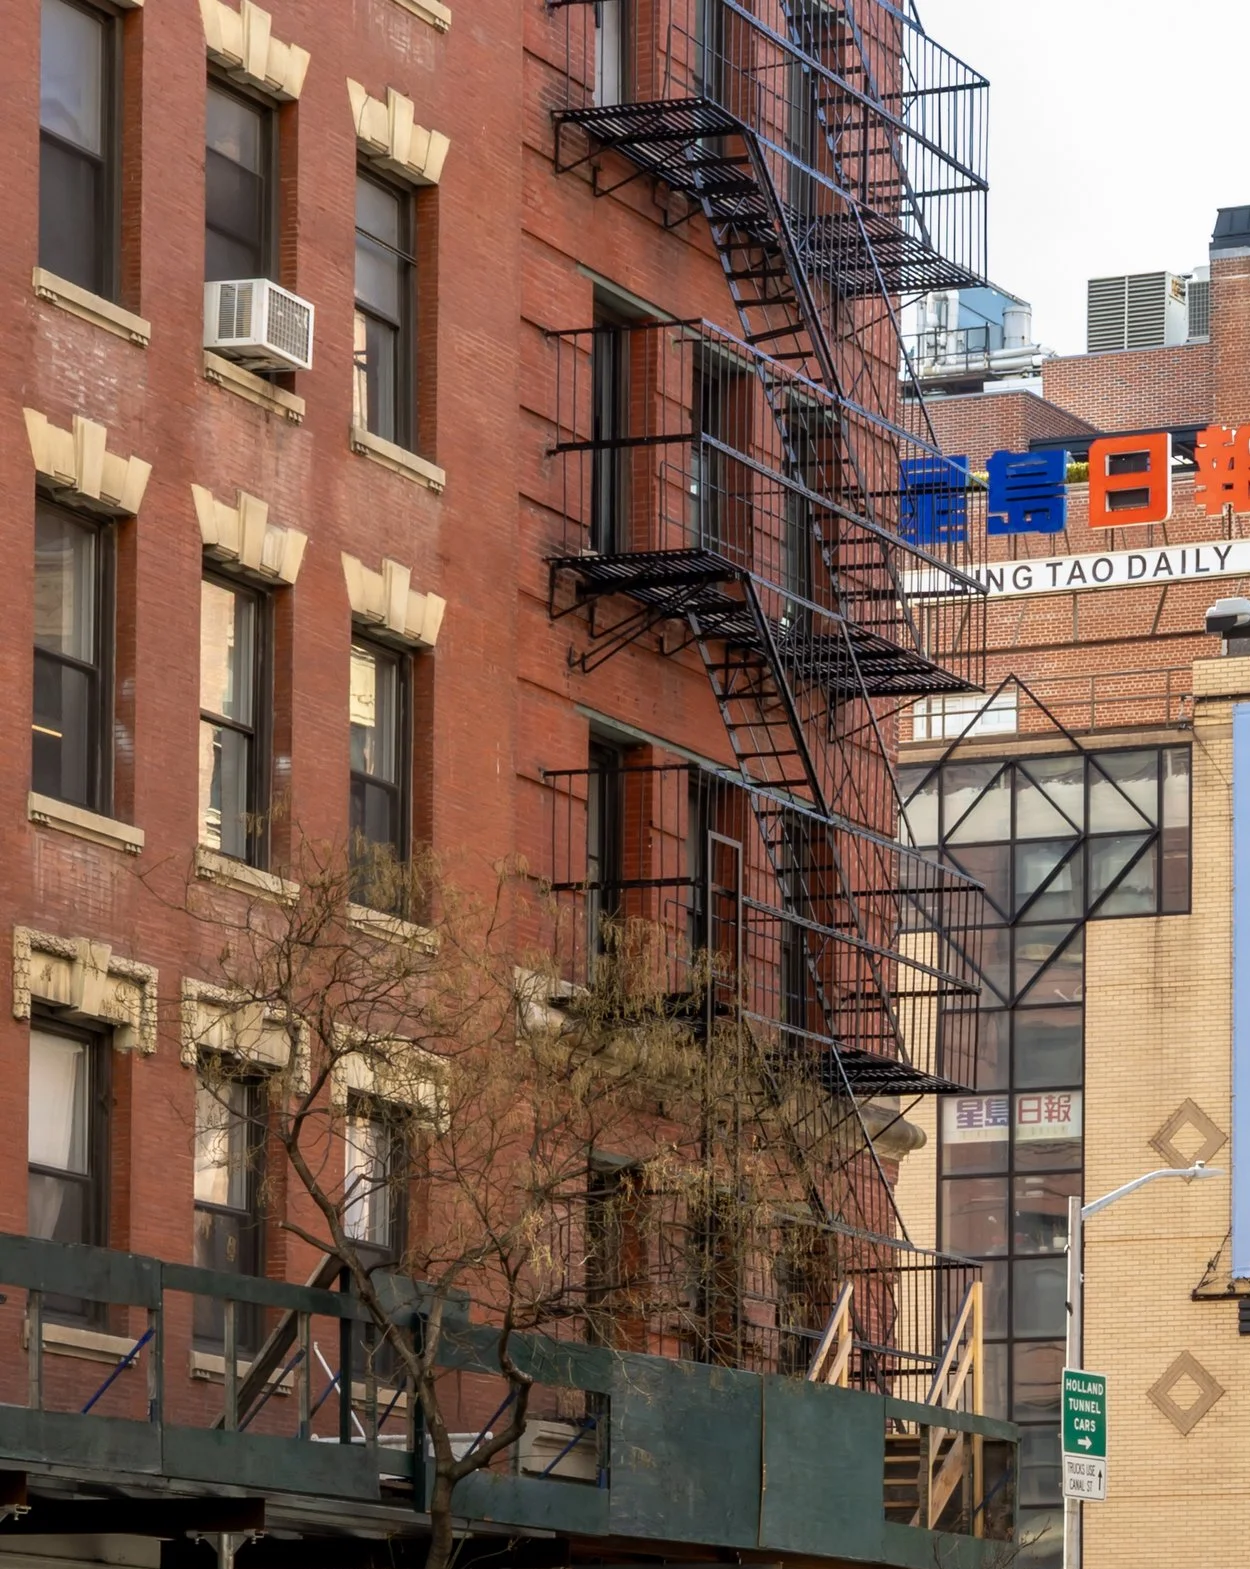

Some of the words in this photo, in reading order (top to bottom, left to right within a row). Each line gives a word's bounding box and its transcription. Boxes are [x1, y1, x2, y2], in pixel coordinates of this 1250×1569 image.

[951, 564, 1033, 593] ING
[1045, 557, 1114, 588] TAO
[1126, 544, 1232, 579] DAILY
[956, 1094, 1071, 1130] 星島日報
[1065, 1378, 1104, 1395] HOLLAND
[1068, 1398, 1101, 1414] TUNNEL
[1074, 1418, 1096, 1432] CARS
[1067, 1462, 1085, 1475] TRUCKS
[1086, 1463, 1096, 1477] USE
[1069, 1479, 1085, 1491] CANAL
[1086, 1481, 1093, 1492] ST
